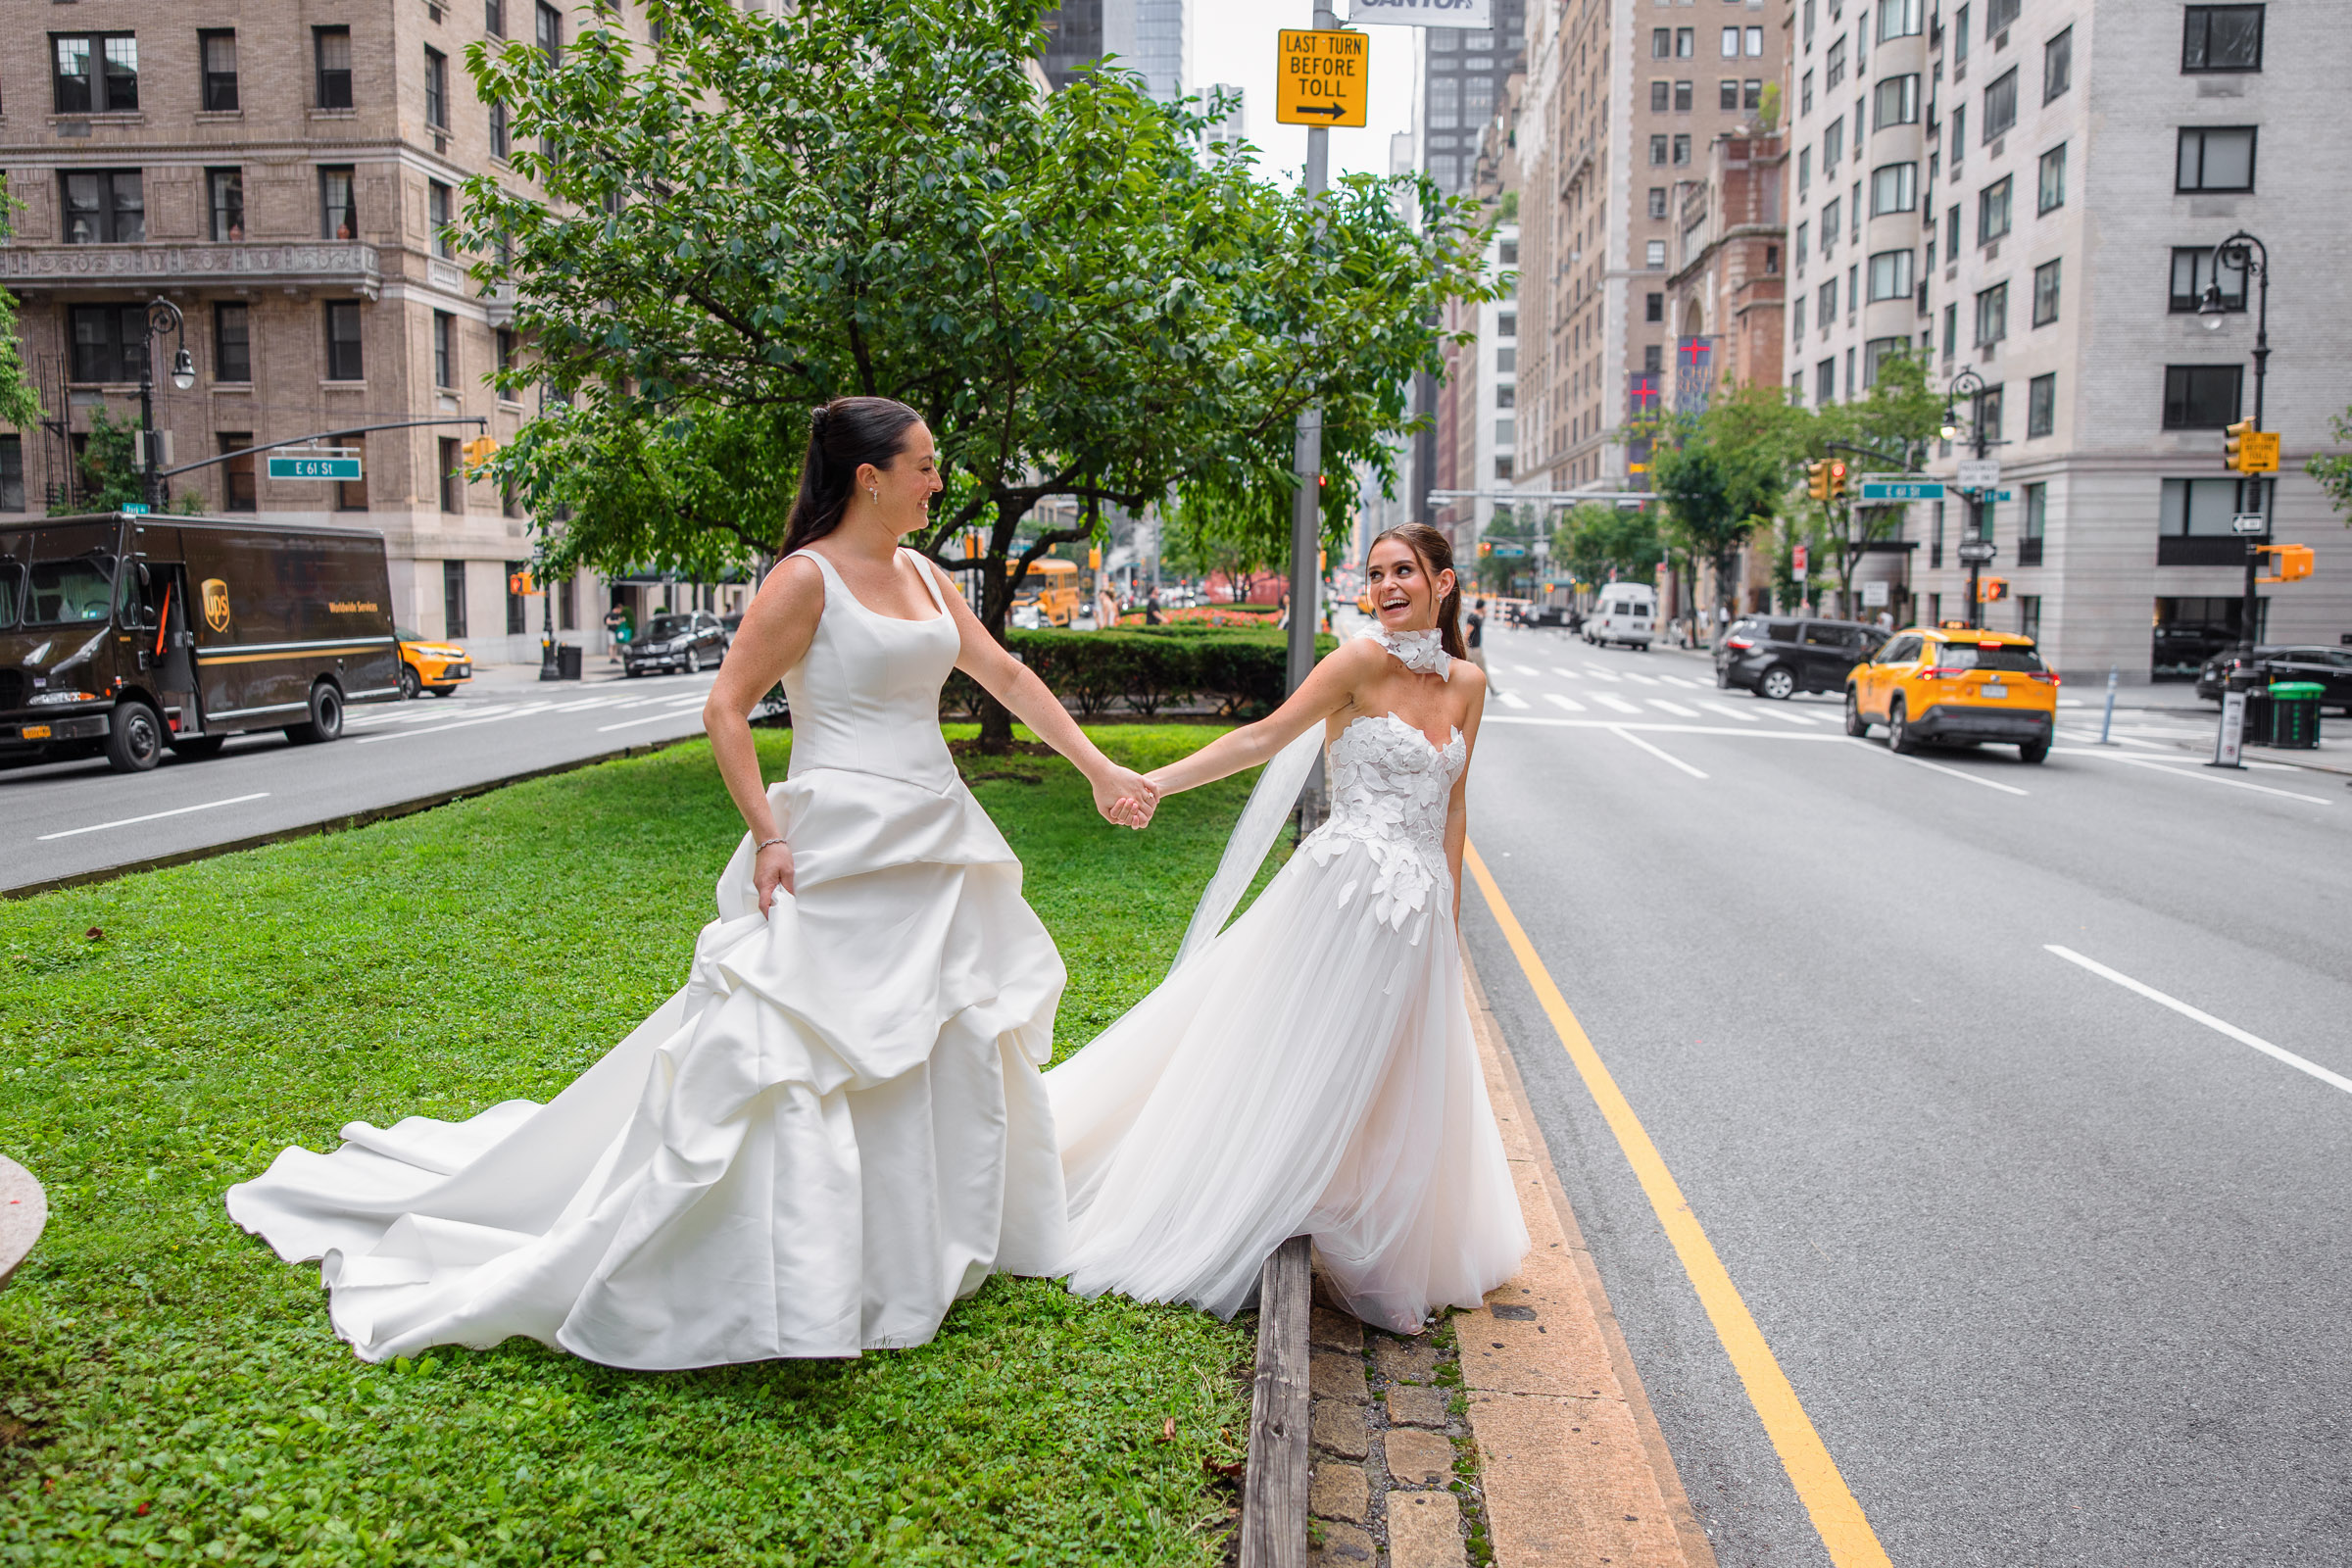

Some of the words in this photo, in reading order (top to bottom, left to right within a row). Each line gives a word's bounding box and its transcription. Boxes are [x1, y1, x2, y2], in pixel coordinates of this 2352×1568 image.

[1286, 34, 1317, 53] LAST
[1328, 36, 1361, 55] TURN
[1291, 56, 1355, 76] BEFORE
[1298, 78, 1347, 97] TOLL
[296, 462, 303, 475] E
[307, 462, 318, 475] 61
[321, 462, 333, 475] St
[206, 594, 228, 625] ups
[328, 601, 357, 613] Worldwide
[357, 600, 378, 612] Services
